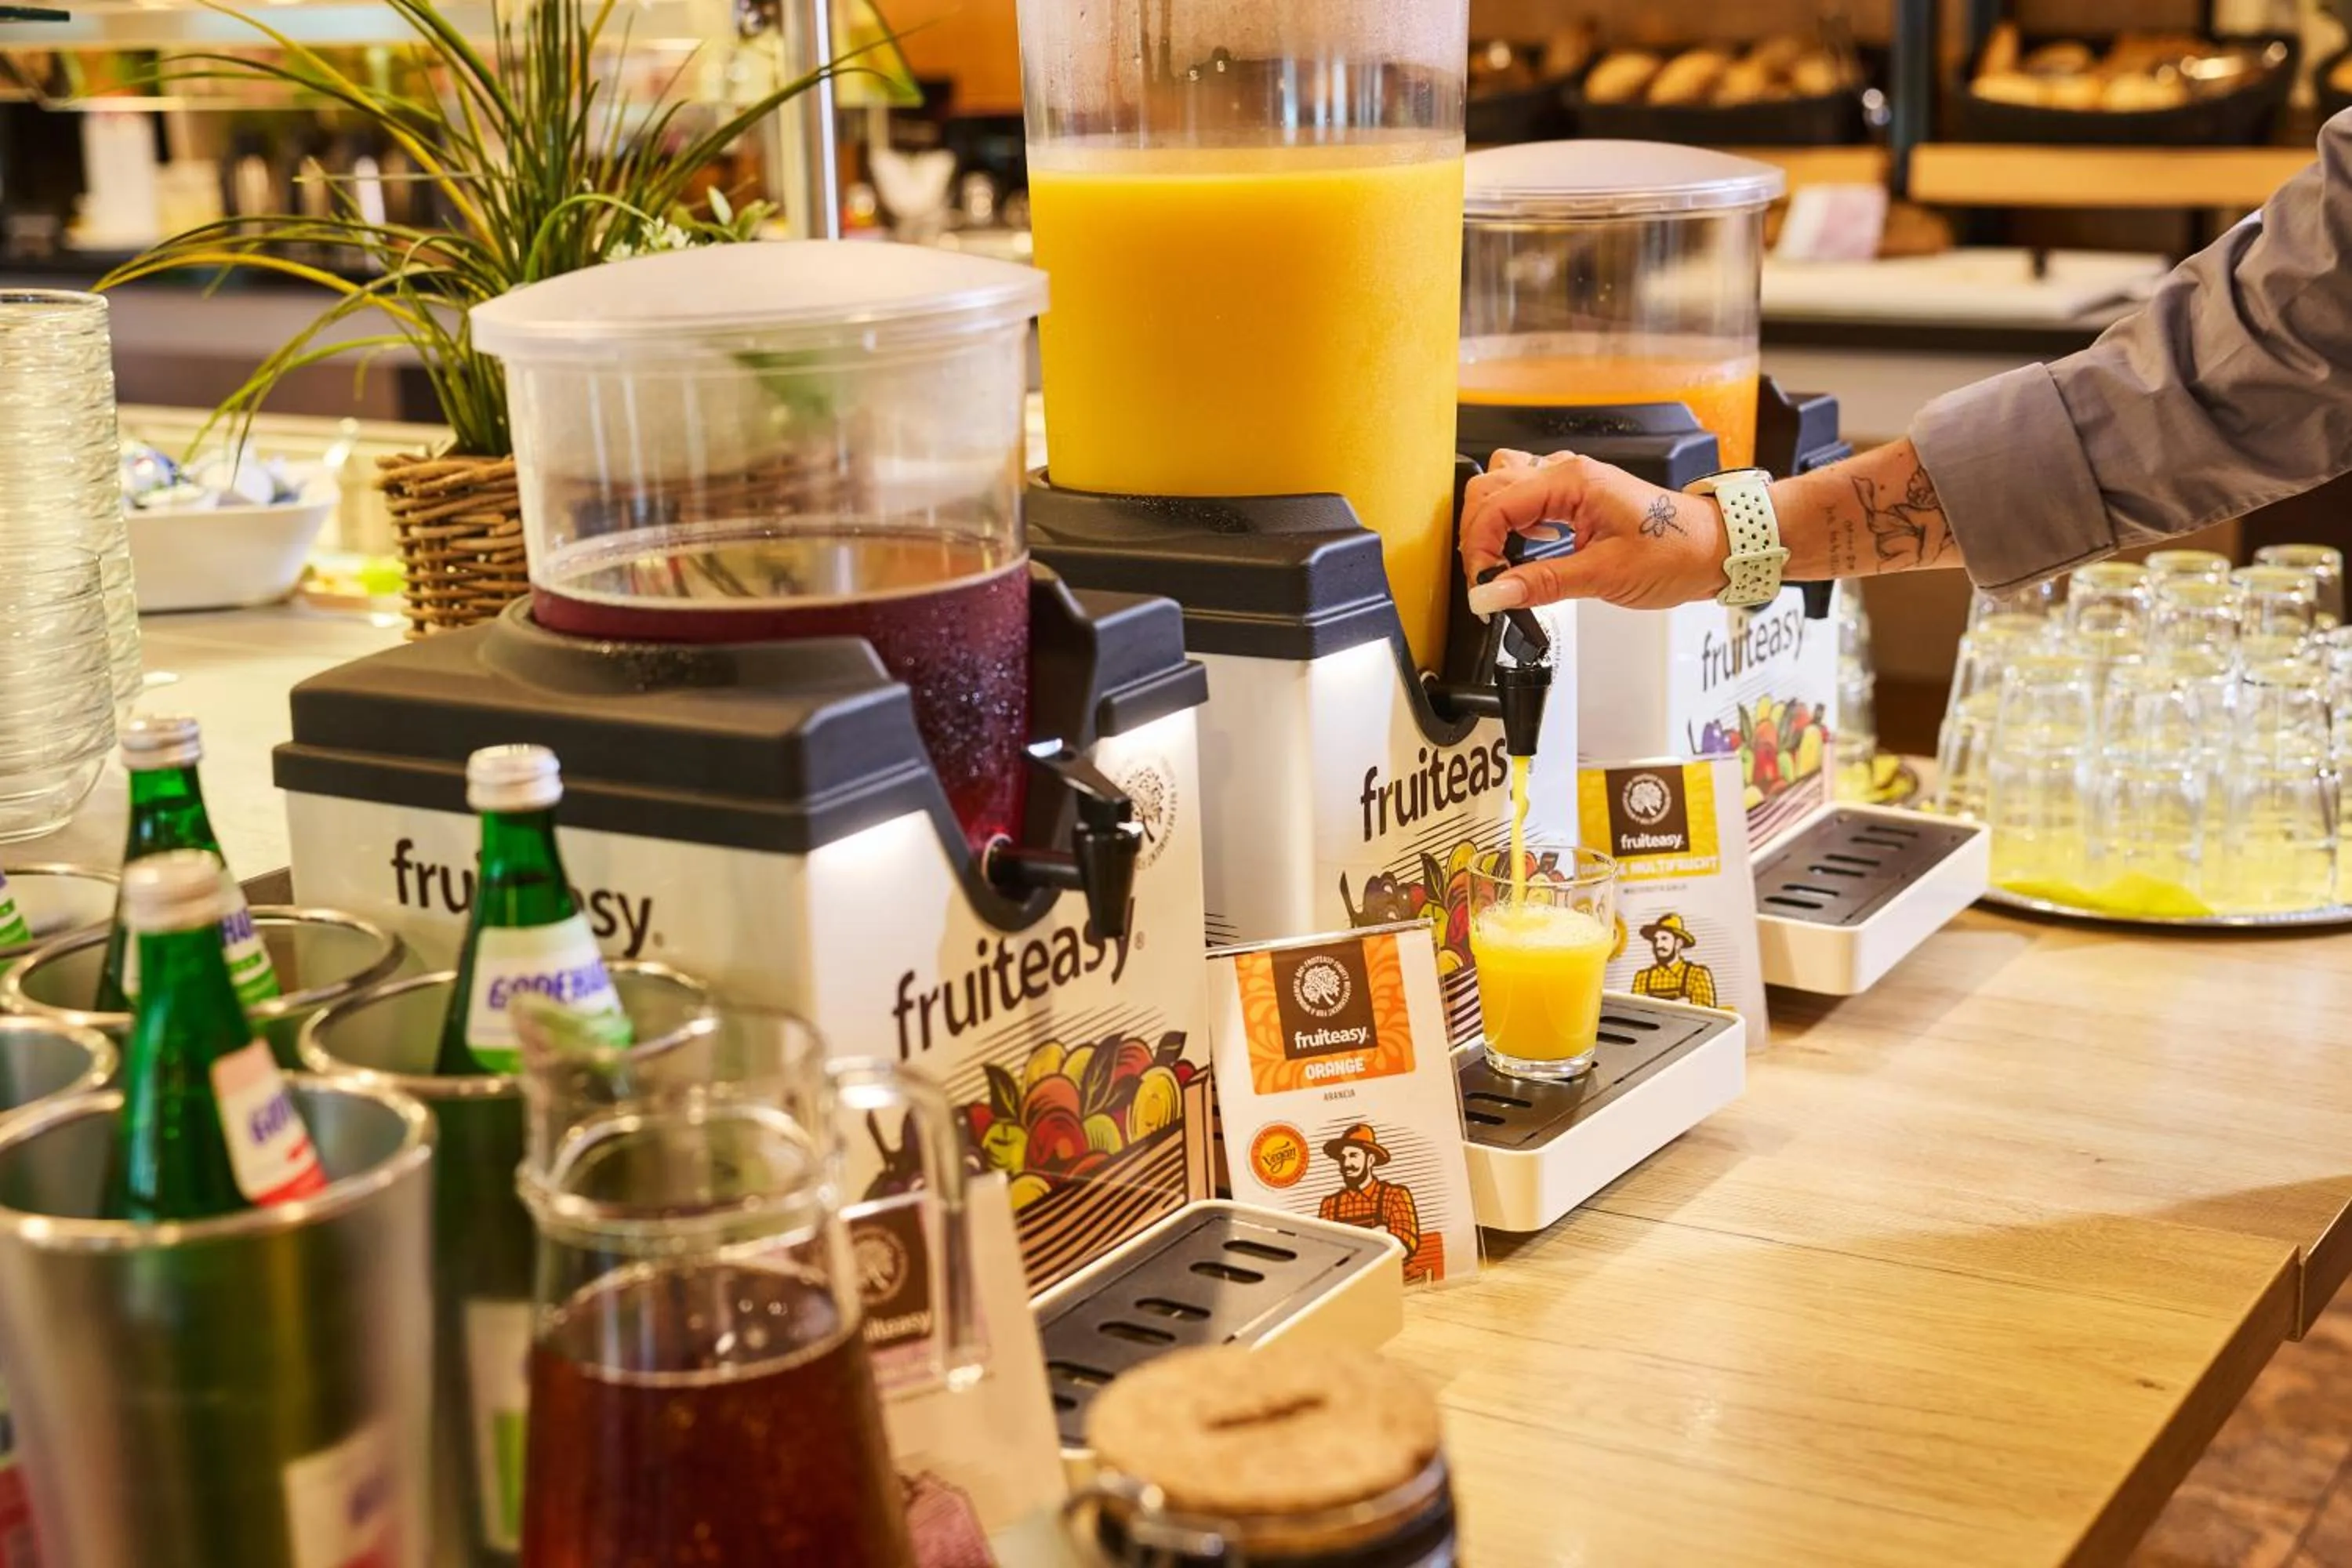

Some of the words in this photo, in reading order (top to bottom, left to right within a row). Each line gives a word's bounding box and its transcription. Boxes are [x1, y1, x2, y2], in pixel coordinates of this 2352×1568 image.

[1701, 608, 1803, 691] fruiteasy
[1361, 738, 1514, 842] fruiteas
[1621, 833, 1682, 849] fruiteasy
[391, 838, 652, 958] frusy
[1294, 1026, 1367, 1049] fruiteasy
[1305, 1057, 1366, 1080] ORANGE
